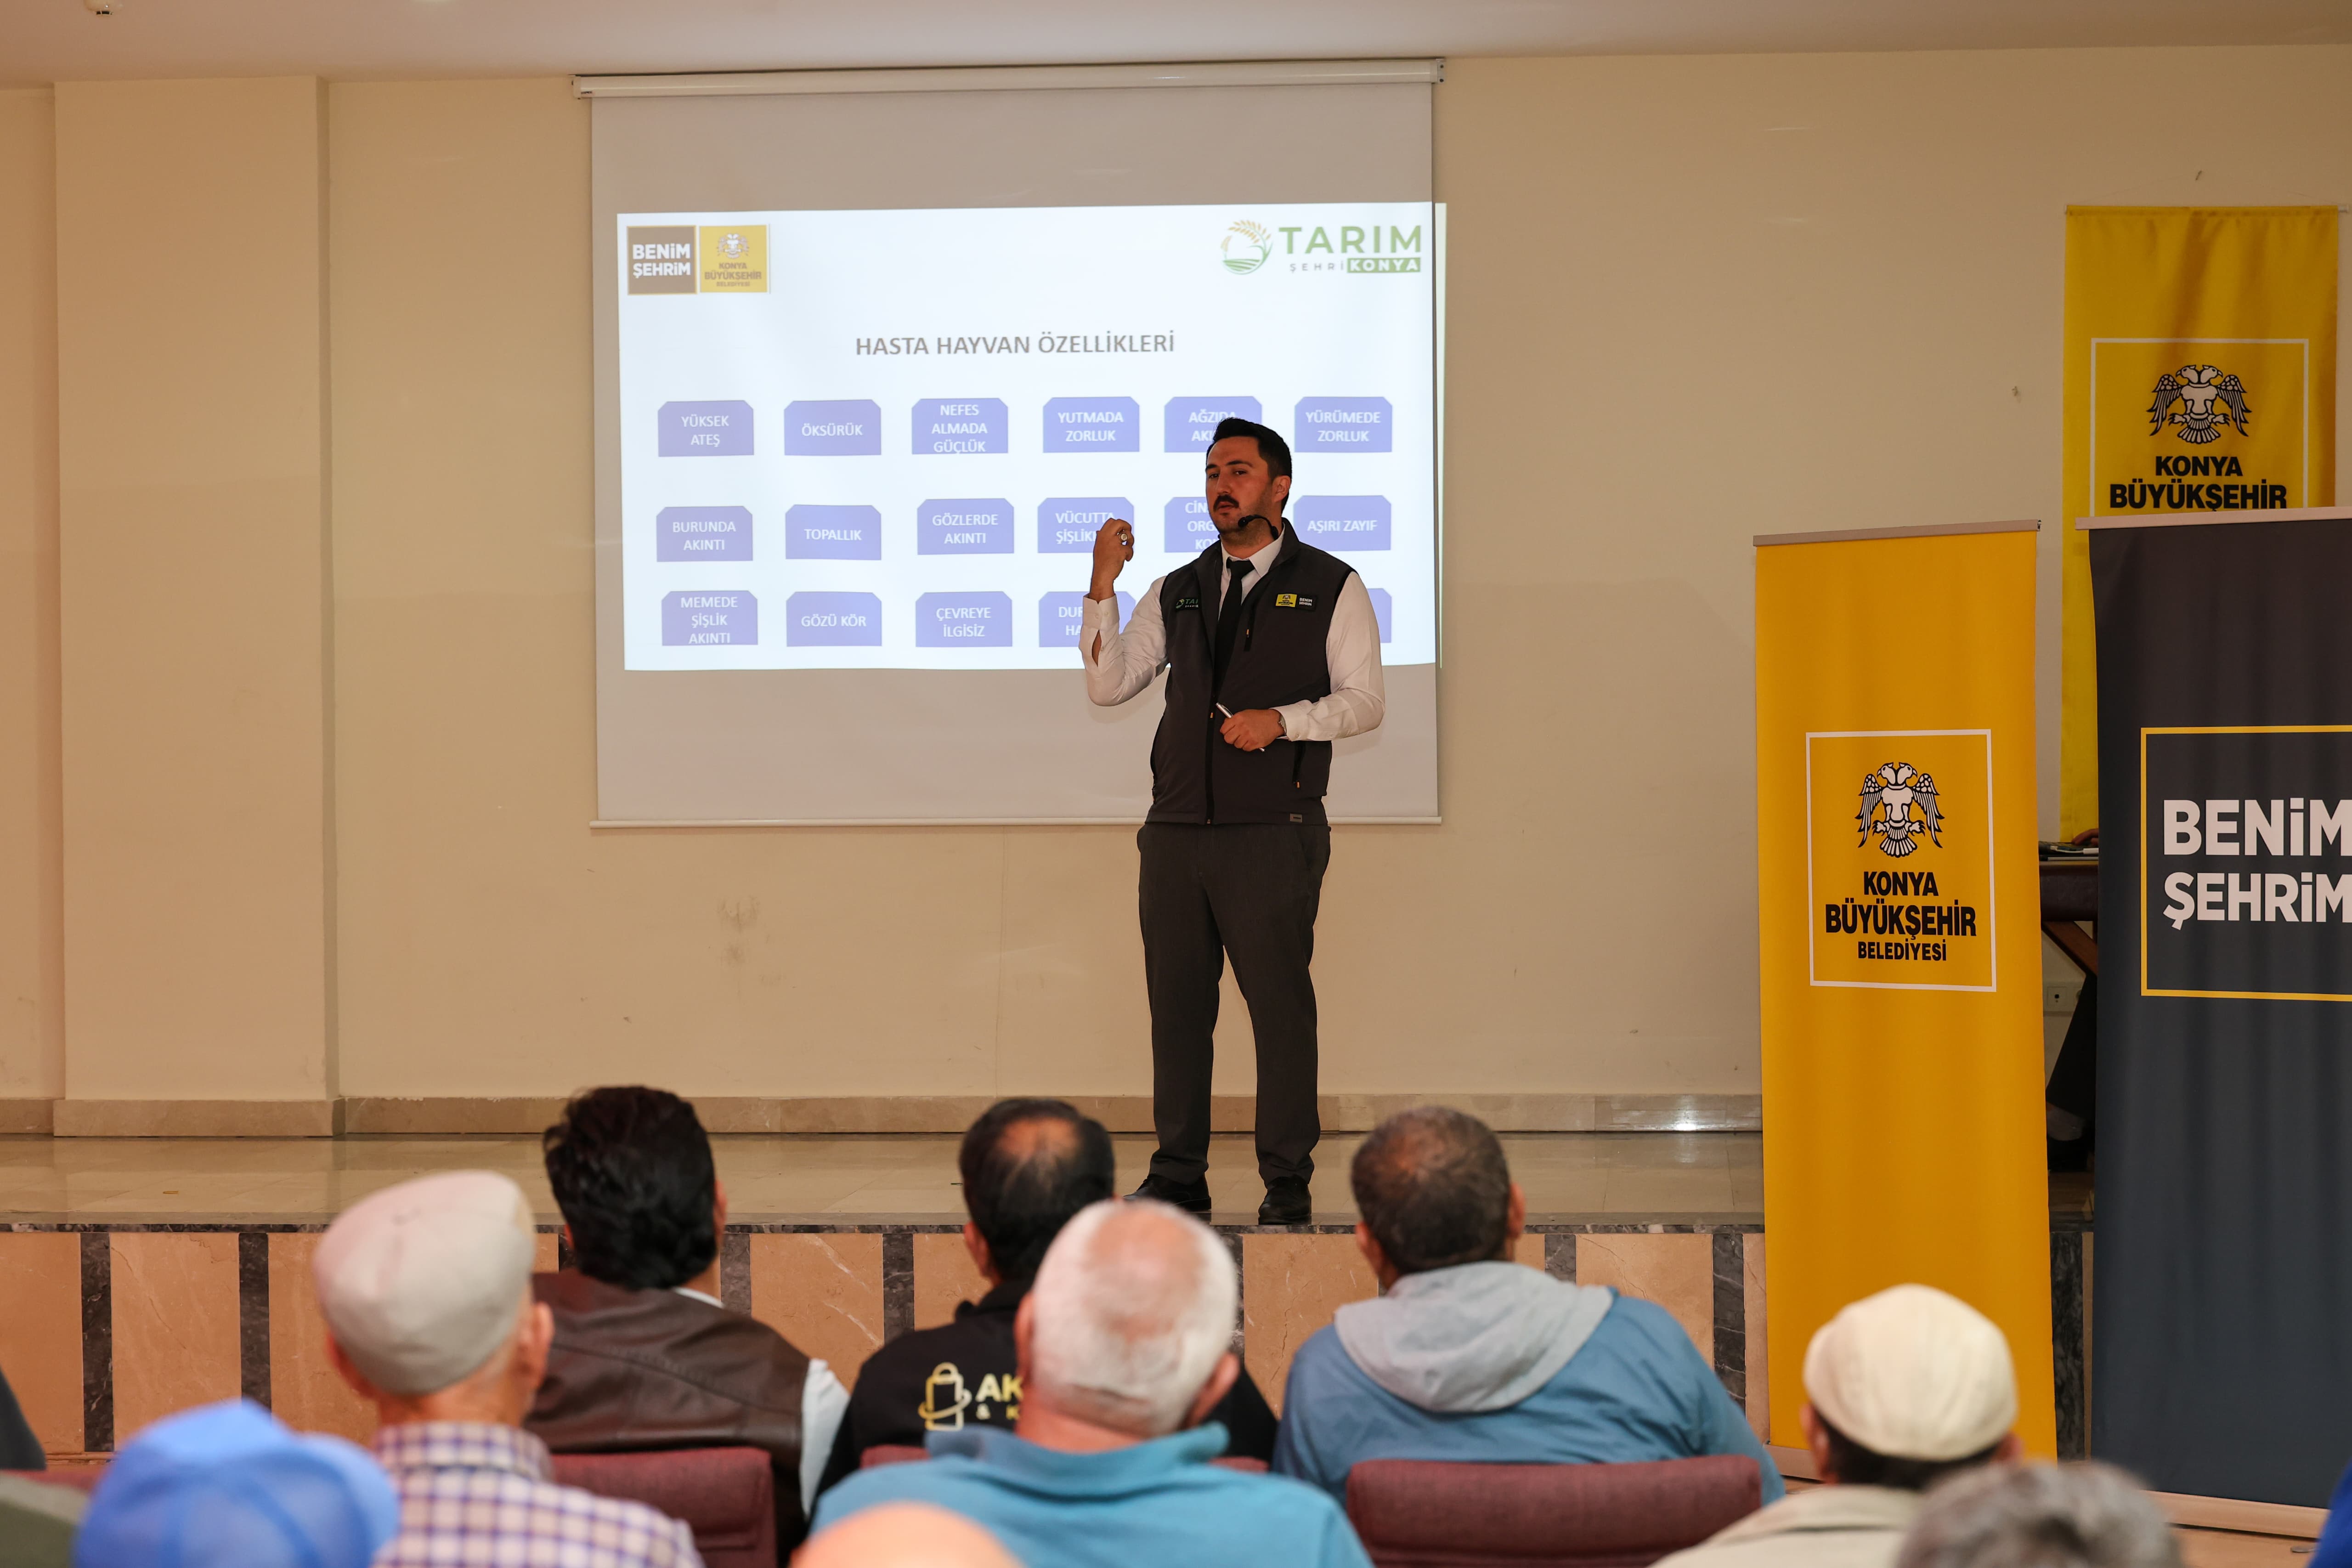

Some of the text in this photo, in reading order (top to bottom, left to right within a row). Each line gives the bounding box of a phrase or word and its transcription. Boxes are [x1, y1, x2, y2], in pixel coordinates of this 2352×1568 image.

[1278, 225, 1421, 254] TARIM
[1289, 258, 1419, 273] ŞEHRİ KONYA
[856, 330, 1174, 355] HASTA HAYVAN ÖZELLİKLERİ
[940, 404, 979, 416] NEFES
[1306, 409, 1381, 423] YÜRÜMEDE
[681, 414, 729, 427] YÜKSEK
[1058, 412, 1124, 423] YUTMADA
[802, 422, 863, 436] ÖKSÜRÜK
[931, 423, 988, 434] ALMADA
[690, 434, 721, 447] ATEŞ
[1065, 430, 1116, 442] ZORLUK
[1191, 430, 1215, 442] AKI
[1317, 430, 1370, 442] ZORLUK
[933, 439, 986, 454] GÜÇLÜK
[2155, 456, 2243, 476] KONYA
[2109, 478, 2287, 511] BÜYÜKŞEHİR
[1185, 500, 1209, 514] CİN
[932, 513, 999, 526] GÖZLERDE
[673, 521, 736, 533] BURUNDA
[1187, 521, 1217, 532] ORG
[1307, 520, 1378, 534] AŞIRI ZAYIF
[804, 529, 862, 541] TOPALLIK
[944, 532, 986, 544] AKINTI
[683, 539, 724, 550] AKINTI
[680, 597, 738, 608] MEMEDE
[691, 612, 728, 628] ŞİŞLİK
[801, 614, 866, 627] GÖZÜ KÖR
[936, 607, 992, 621] ÇEVREYE
[943, 623, 985, 637] İLGİSİZ
[688, 633, 731, 644] AKINTI
[1863, 871, 1939, 896] KONYA
[1825, 897, 1977, 940] BÜYÜKŞEHİR
[1858, 938, 1947, 961] BELEDİYESİ
[975, 1373, 1023, 1402] AK
